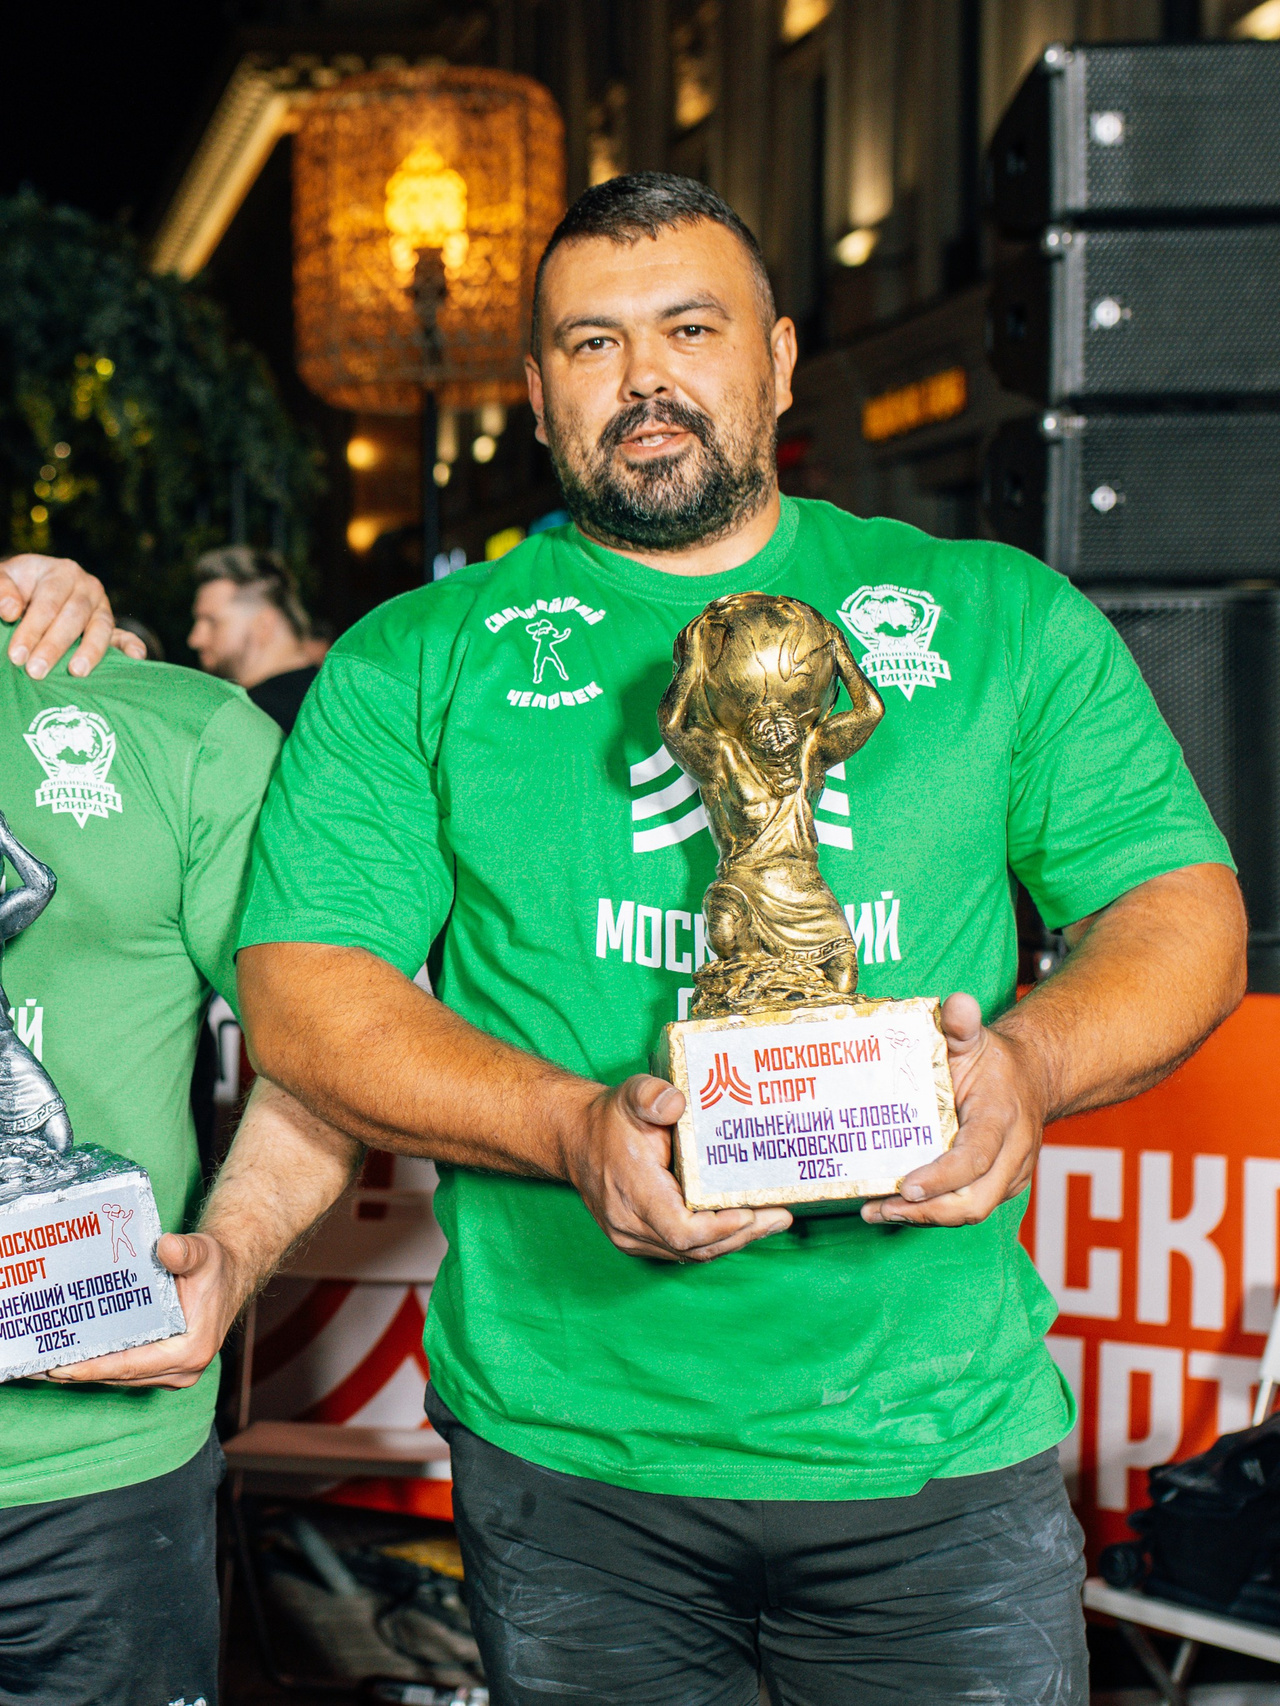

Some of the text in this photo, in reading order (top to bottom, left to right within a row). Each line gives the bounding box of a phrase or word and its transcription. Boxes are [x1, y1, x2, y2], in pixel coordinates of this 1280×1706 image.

[862, 659, 945, 675] НАЦИЯ
[881, 672, 930, 683] МИРА
[506, 681, 604, 710] ЧЕЛОВЕК
[40, 787, 118, 807] НАЦИЯ
[56, 801, 103, 813] МИРА
[596, 890, 902, 974] МОСКИЙ
[753, 1035, 881, 1073] МОСКОВСКИЙ
[758, 1076, 816, 1105] СПОРТ
[715, 1102, 919, 1141] «СИЛЬНЕЙШИЙ ЧЕЛОВЕК»
[706, 1125, 933, 1166] НОЧЬ МОСКОВСКОГО СПОРТА
[798, 1157, 848, 1181] 2025г.
[68, 1268, 138, 1302] ЧЕЛОВЕК»
[99, 1286, 153, 1318] СПОРТА
[35, 1330, 80, 1354] 2025г.
